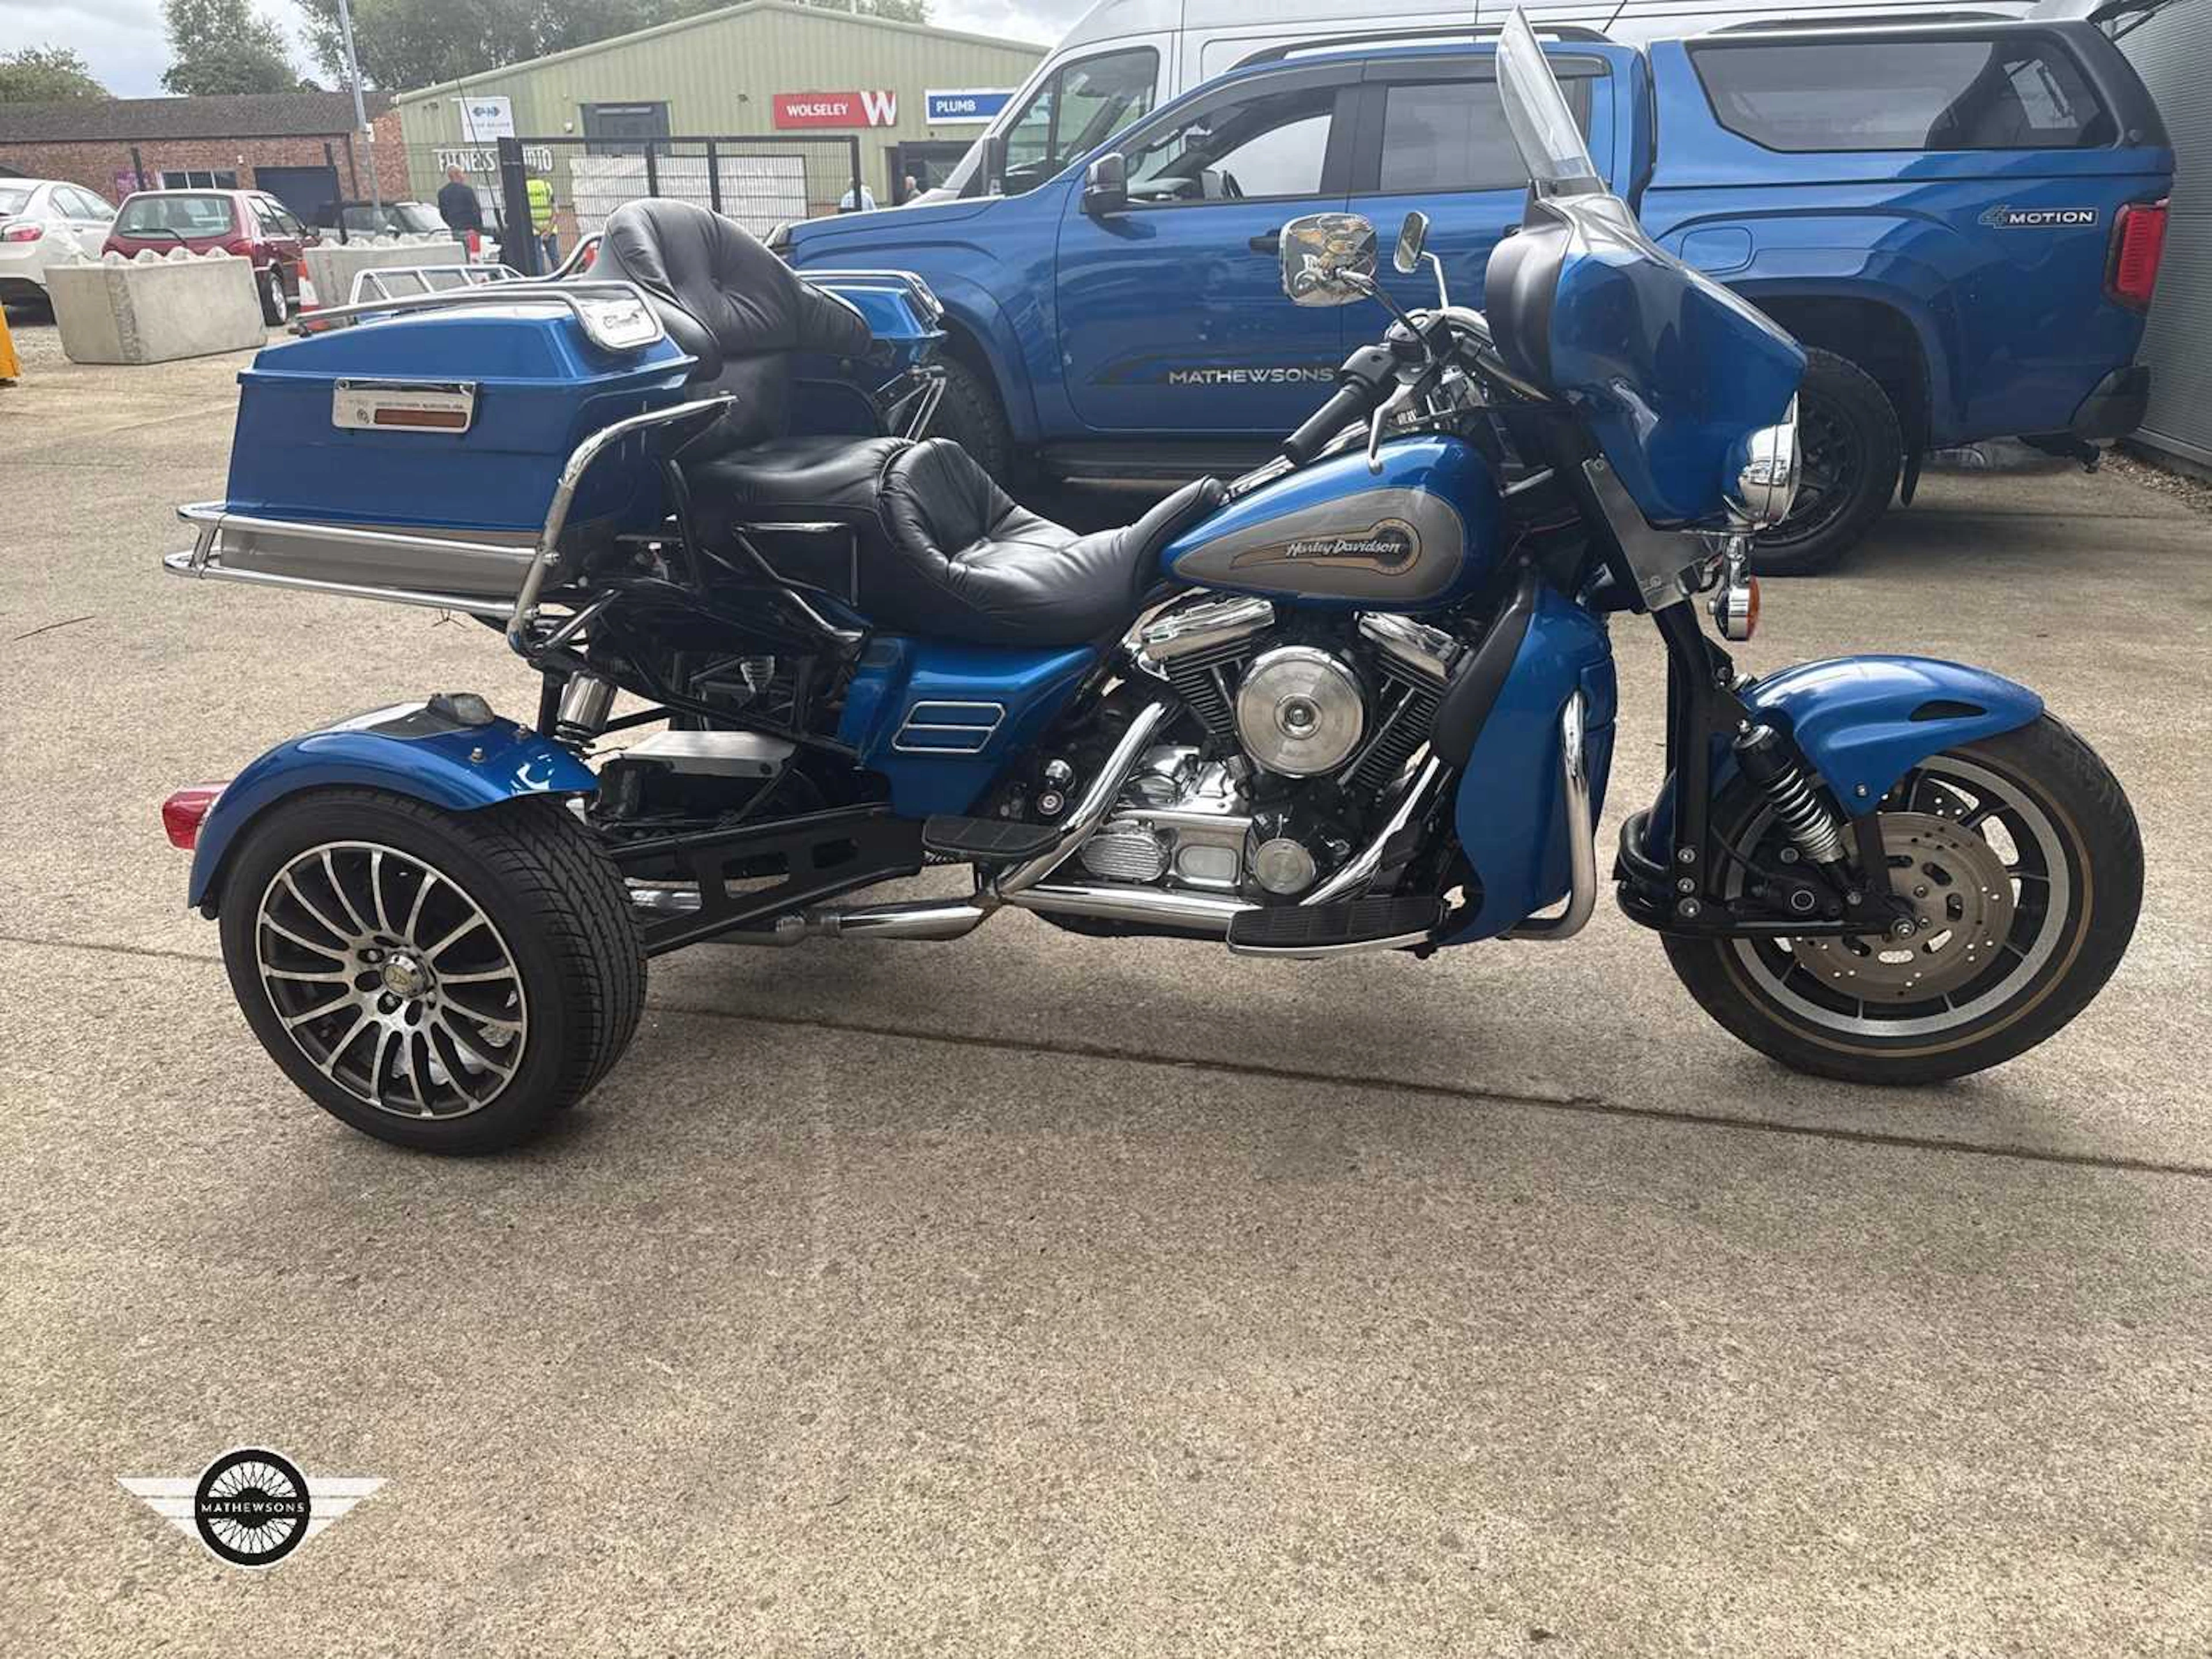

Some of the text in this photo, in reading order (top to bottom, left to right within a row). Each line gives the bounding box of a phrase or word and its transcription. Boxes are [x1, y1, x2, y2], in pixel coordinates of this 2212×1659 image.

[786, 103, 849, 117] WOLSELEY
[861, 91, 896, 126] W
[936, 100, 977, 112] PLUMB
[1168, 368, 1335, 385] MATHEWSONS
